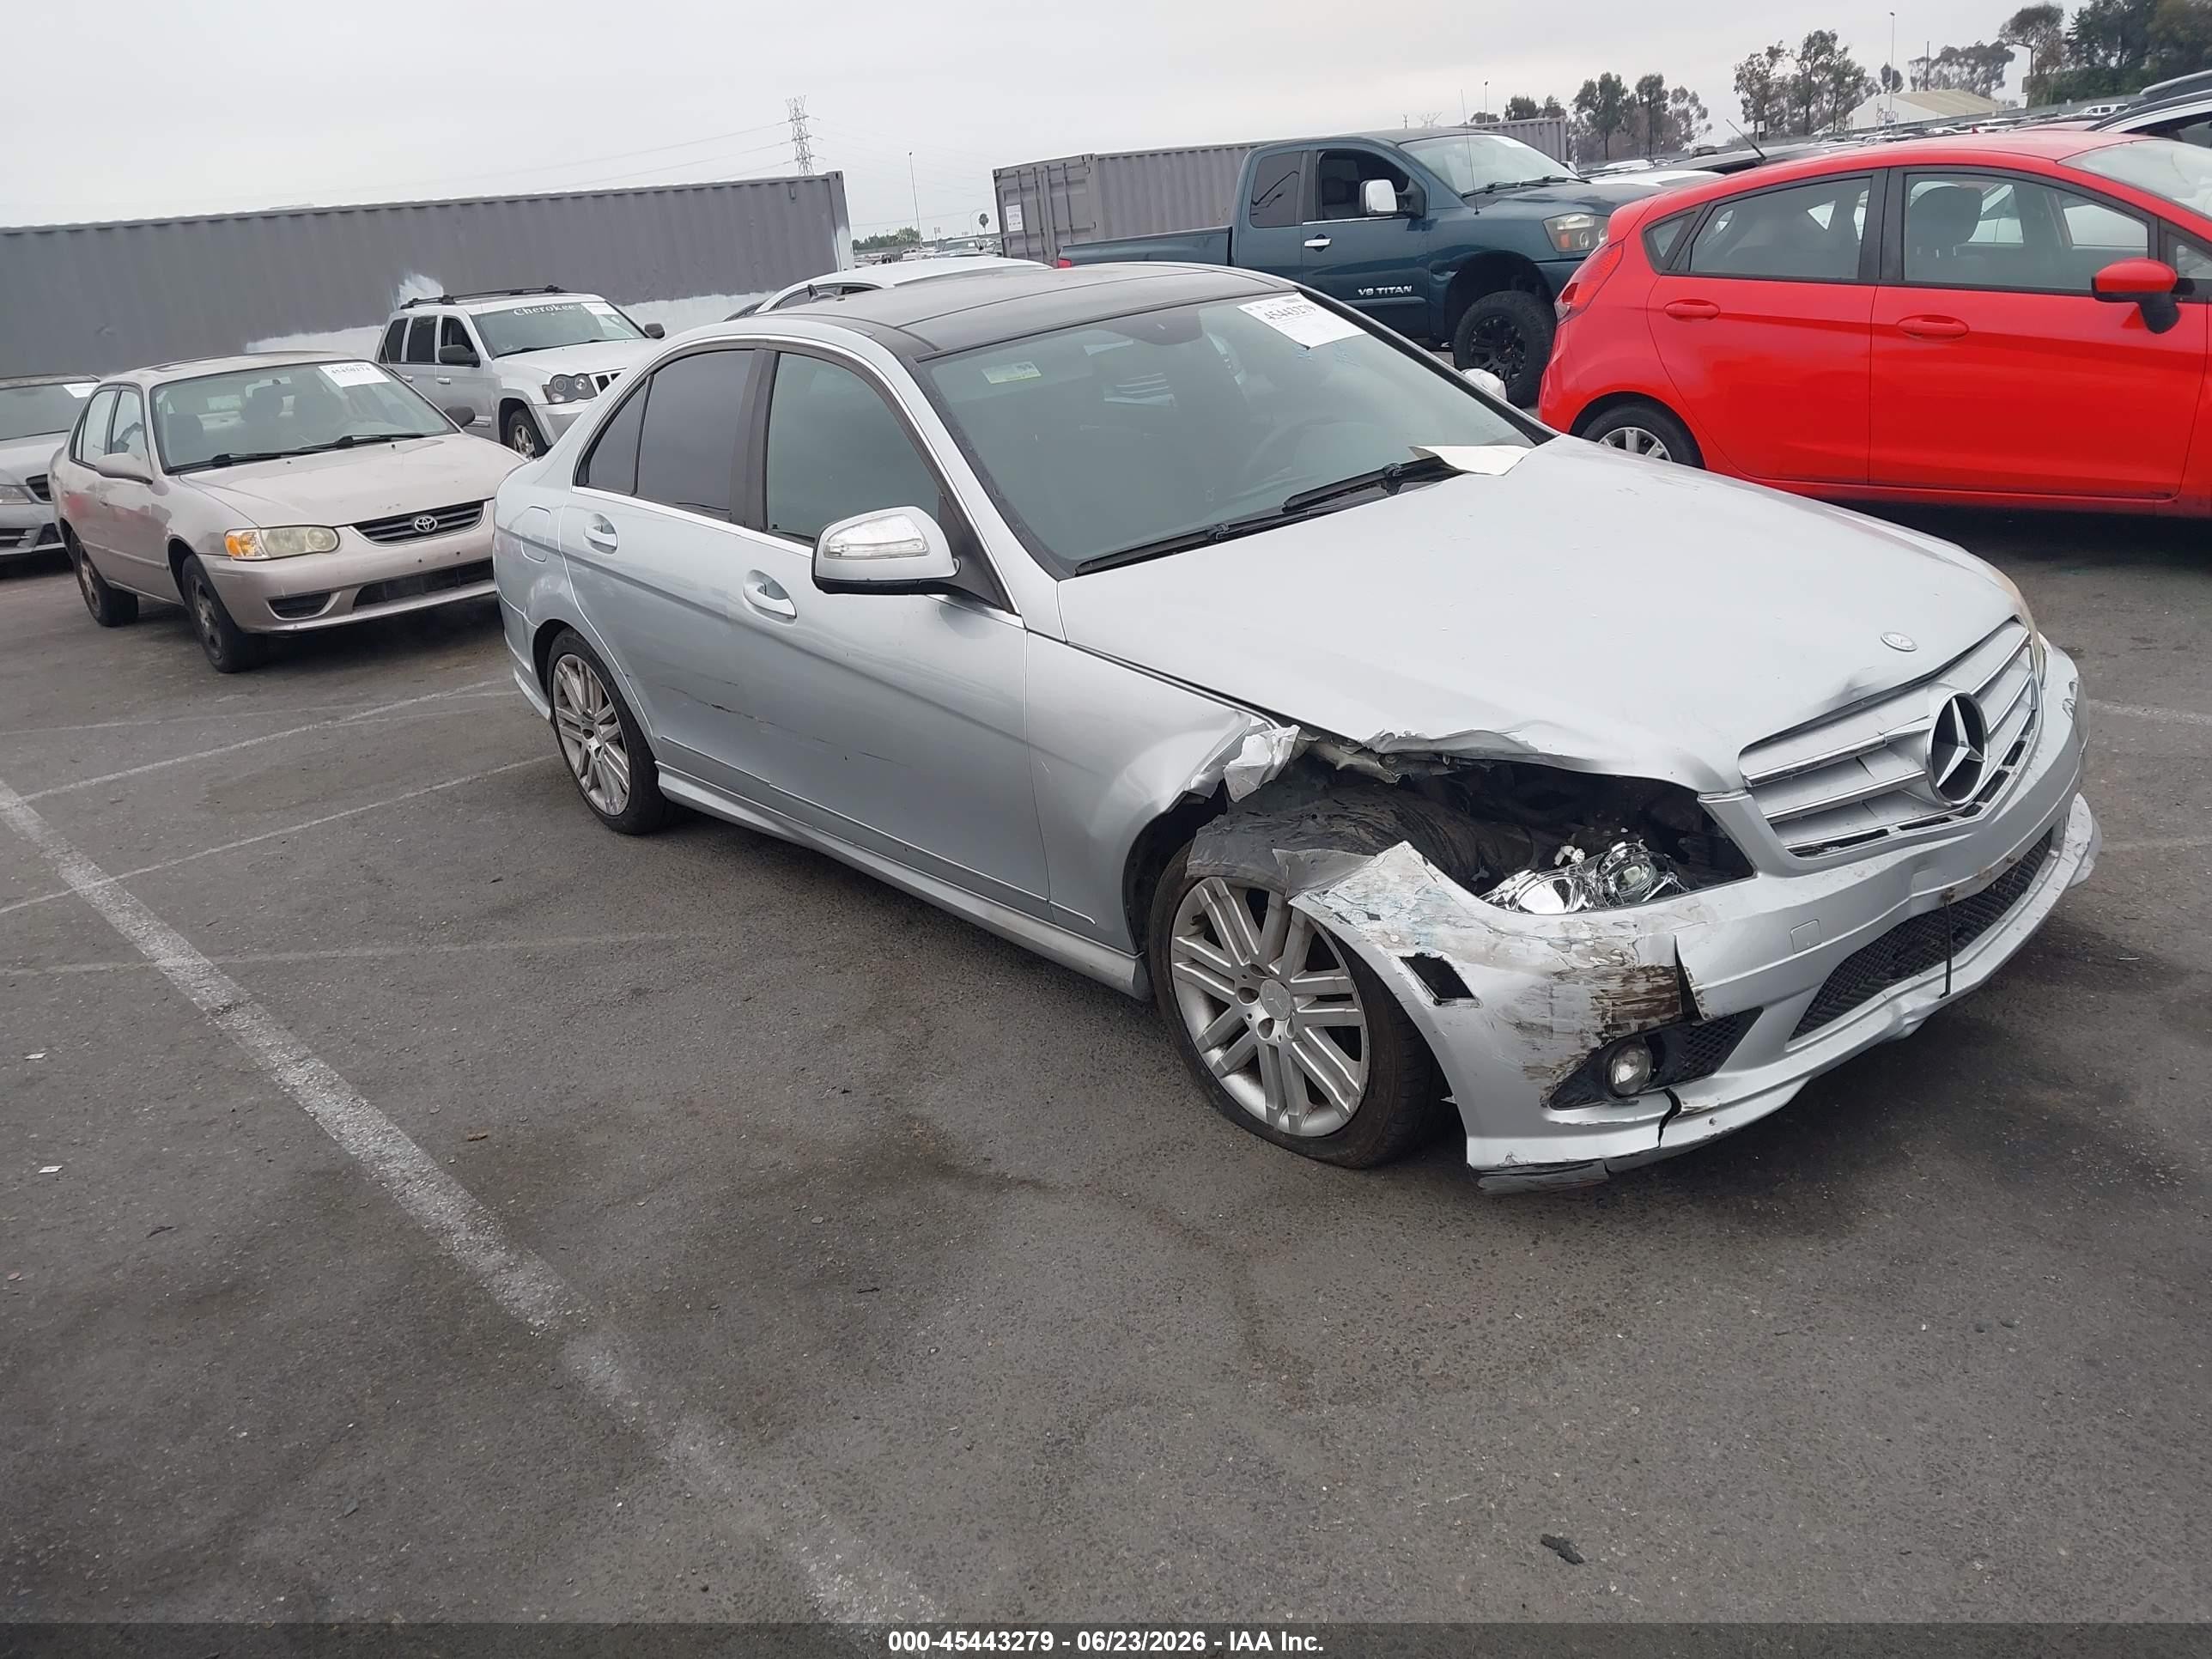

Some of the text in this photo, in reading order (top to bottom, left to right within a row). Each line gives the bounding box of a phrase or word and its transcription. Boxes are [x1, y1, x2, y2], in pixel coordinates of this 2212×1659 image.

[1358, 285, 1412, 296] V8 TITAN
[514, 303, 574, 316] Cherokee
